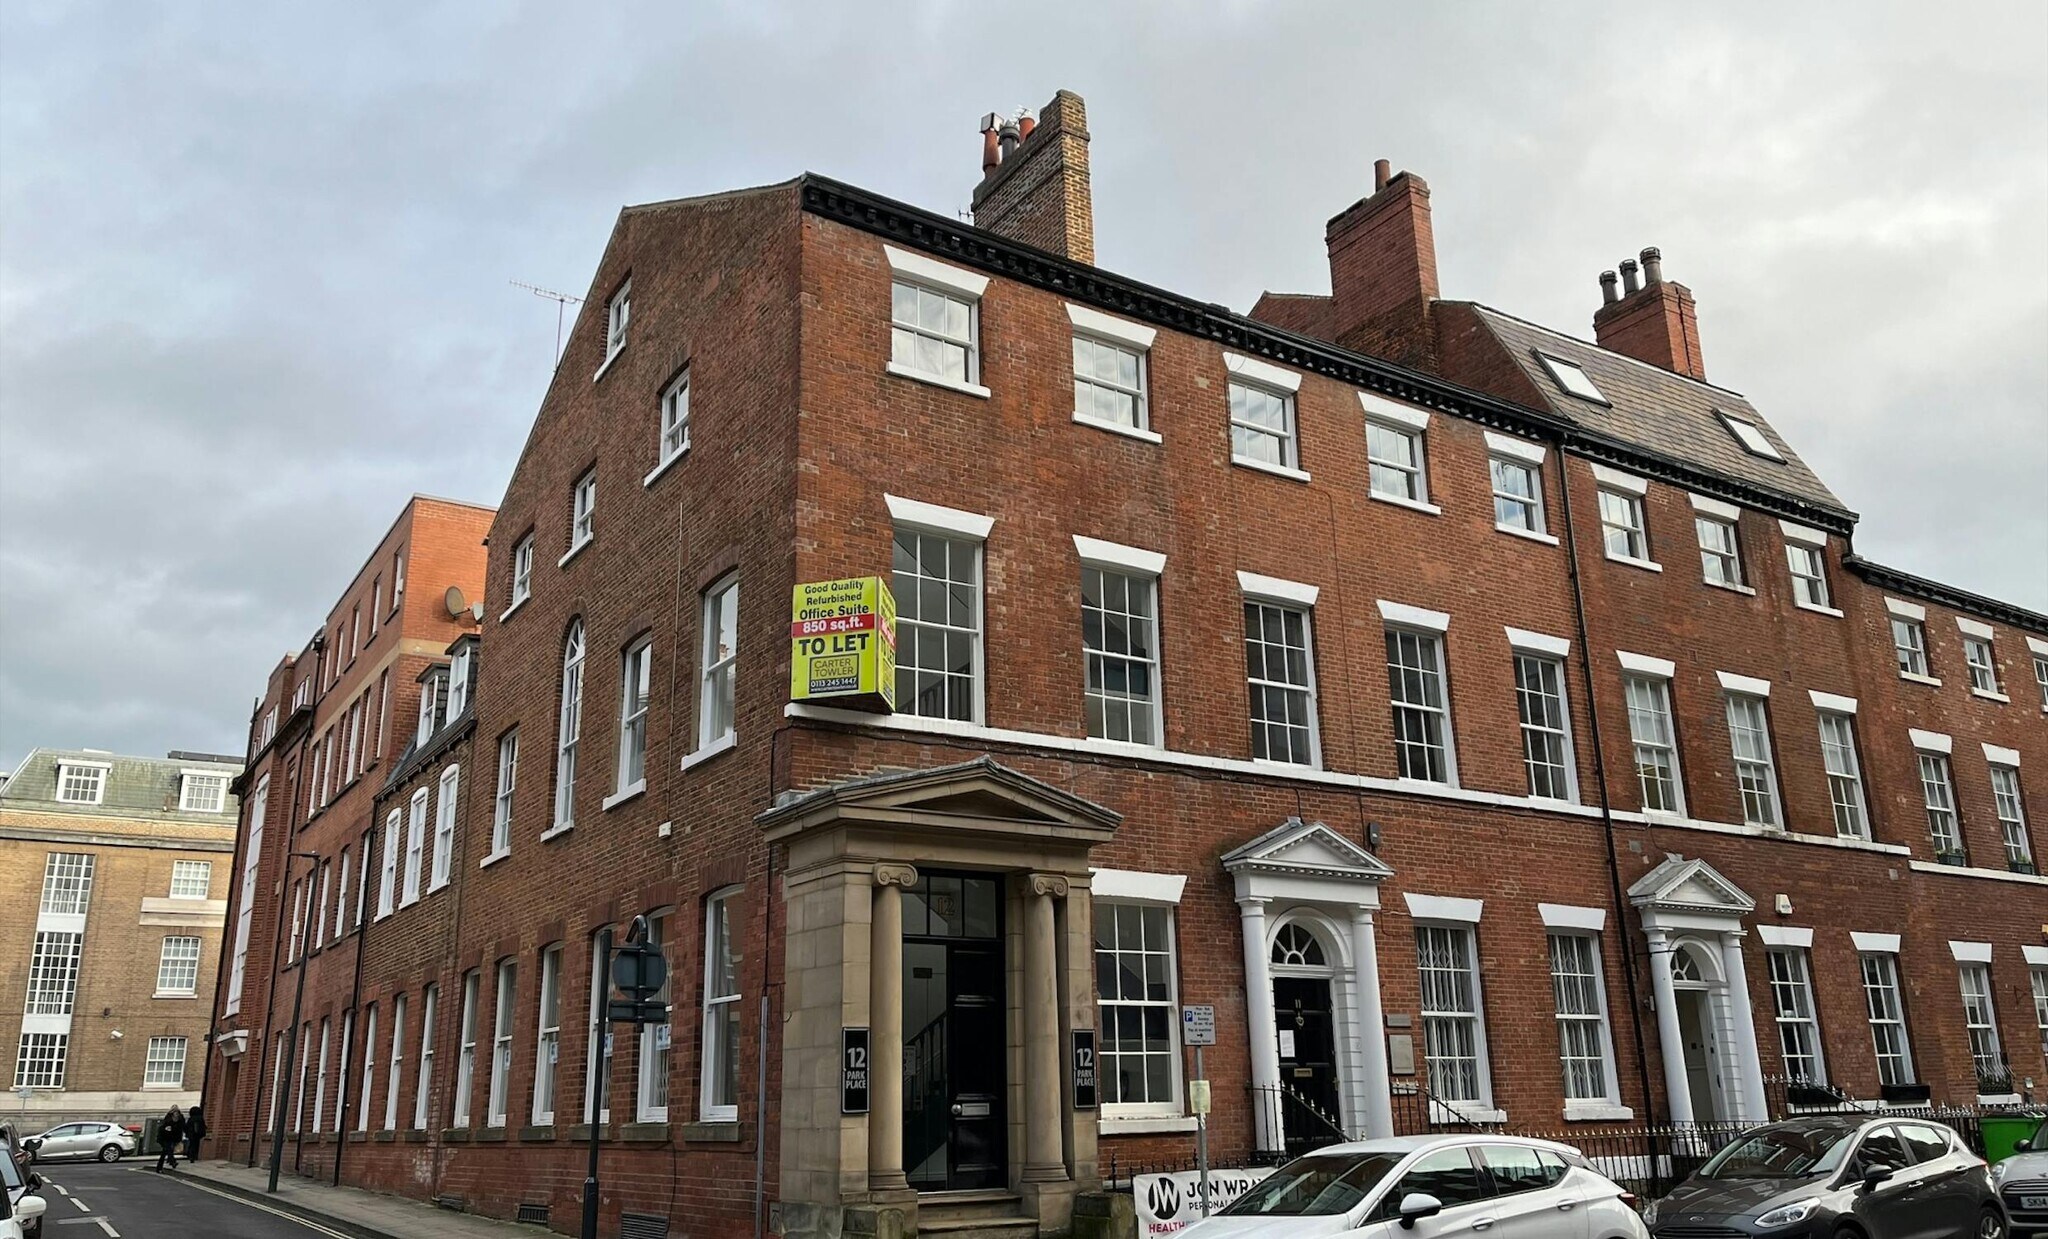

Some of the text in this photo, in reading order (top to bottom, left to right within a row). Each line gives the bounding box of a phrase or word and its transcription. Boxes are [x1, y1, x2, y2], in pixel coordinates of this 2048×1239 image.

[804, 581, 864, 594] Good Quality
[806, 592, 862, 606] Refurbished
[799, 604, 869, 620] Office Suite
[802, 616, 864, 634] 850 sq.ft.
[798, 633, 869, 656] TO LET
[814, 658, 851, 669] CARTER
[815, 667, 854, 678] TOWLER
[810, 680, 826, 688] 0113
[847, 1047, 866, 1068] 12
[1076, 1047, 1093, 1067] 12
[846, 1070, 866, 1080] PARK
[1077, 1069, 1093, 1078] PARK
[845, 1080, 867, 1089] PLACE
[1076, 1077, 1094, 1087] PLACE
[1223, 1178, 1262, 1196] WRA
[1188, 1199, 1228, 1211] PERONA
